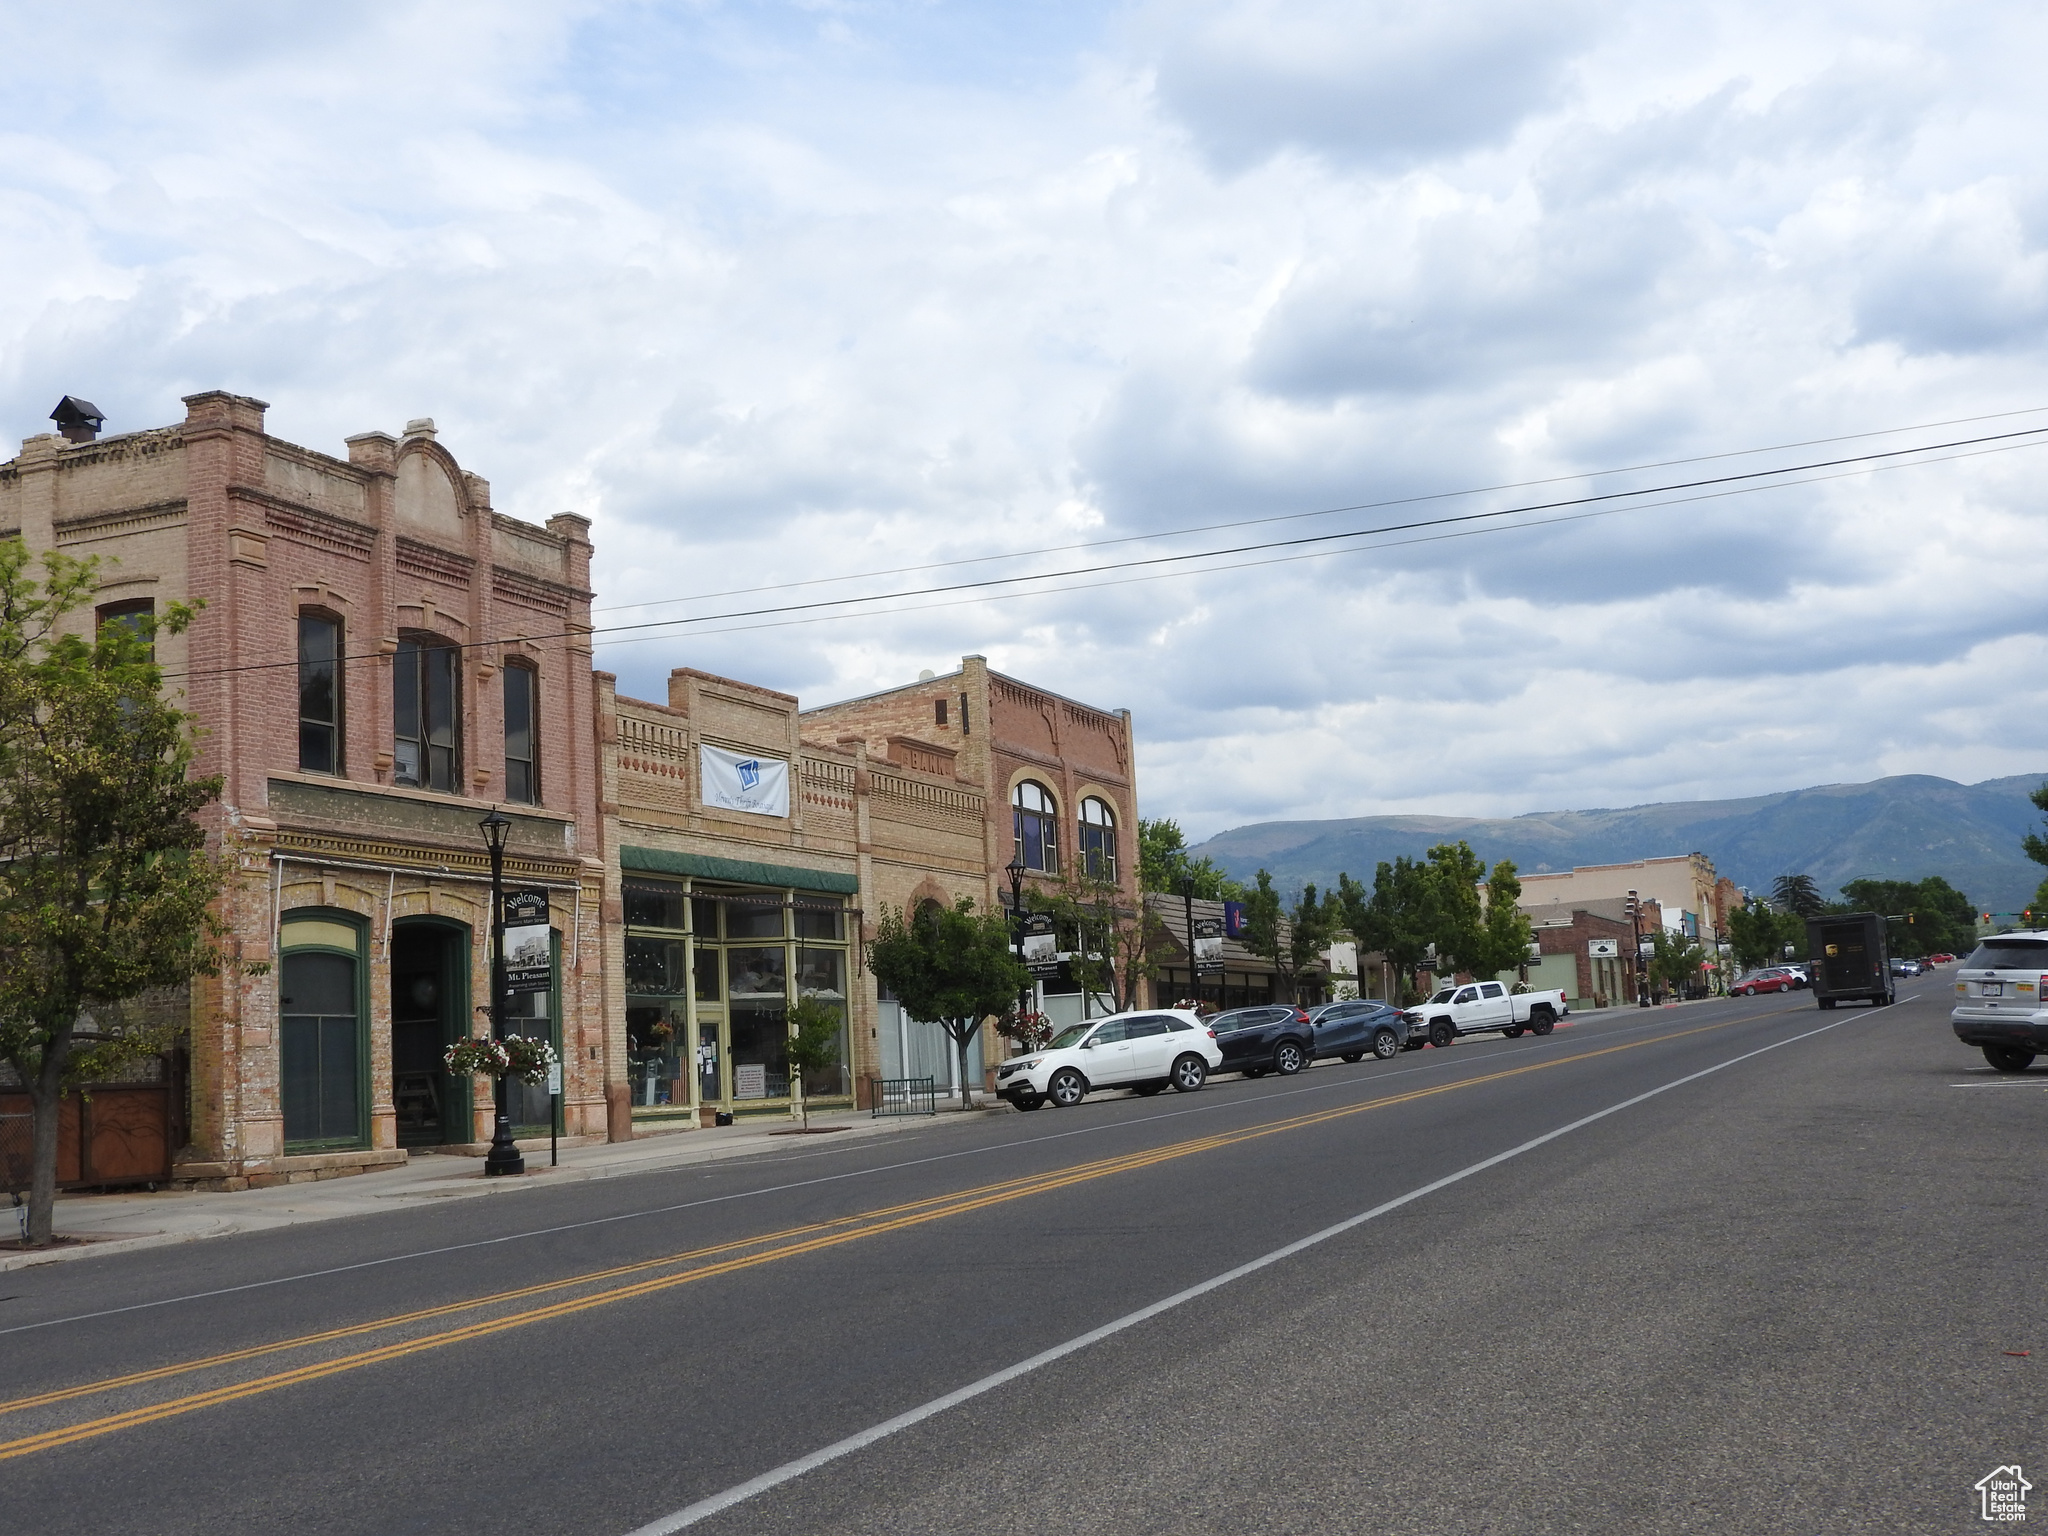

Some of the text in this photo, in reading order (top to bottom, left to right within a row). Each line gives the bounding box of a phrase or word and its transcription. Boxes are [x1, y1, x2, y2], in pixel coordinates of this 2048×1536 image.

[507, 893, 546, 910] Welcome
[1024, 913, 1052, 925] Welcome
[1195, 920, 1220, 930] Welcome
[508, 971, 549, 981] Mt. Pleasant
